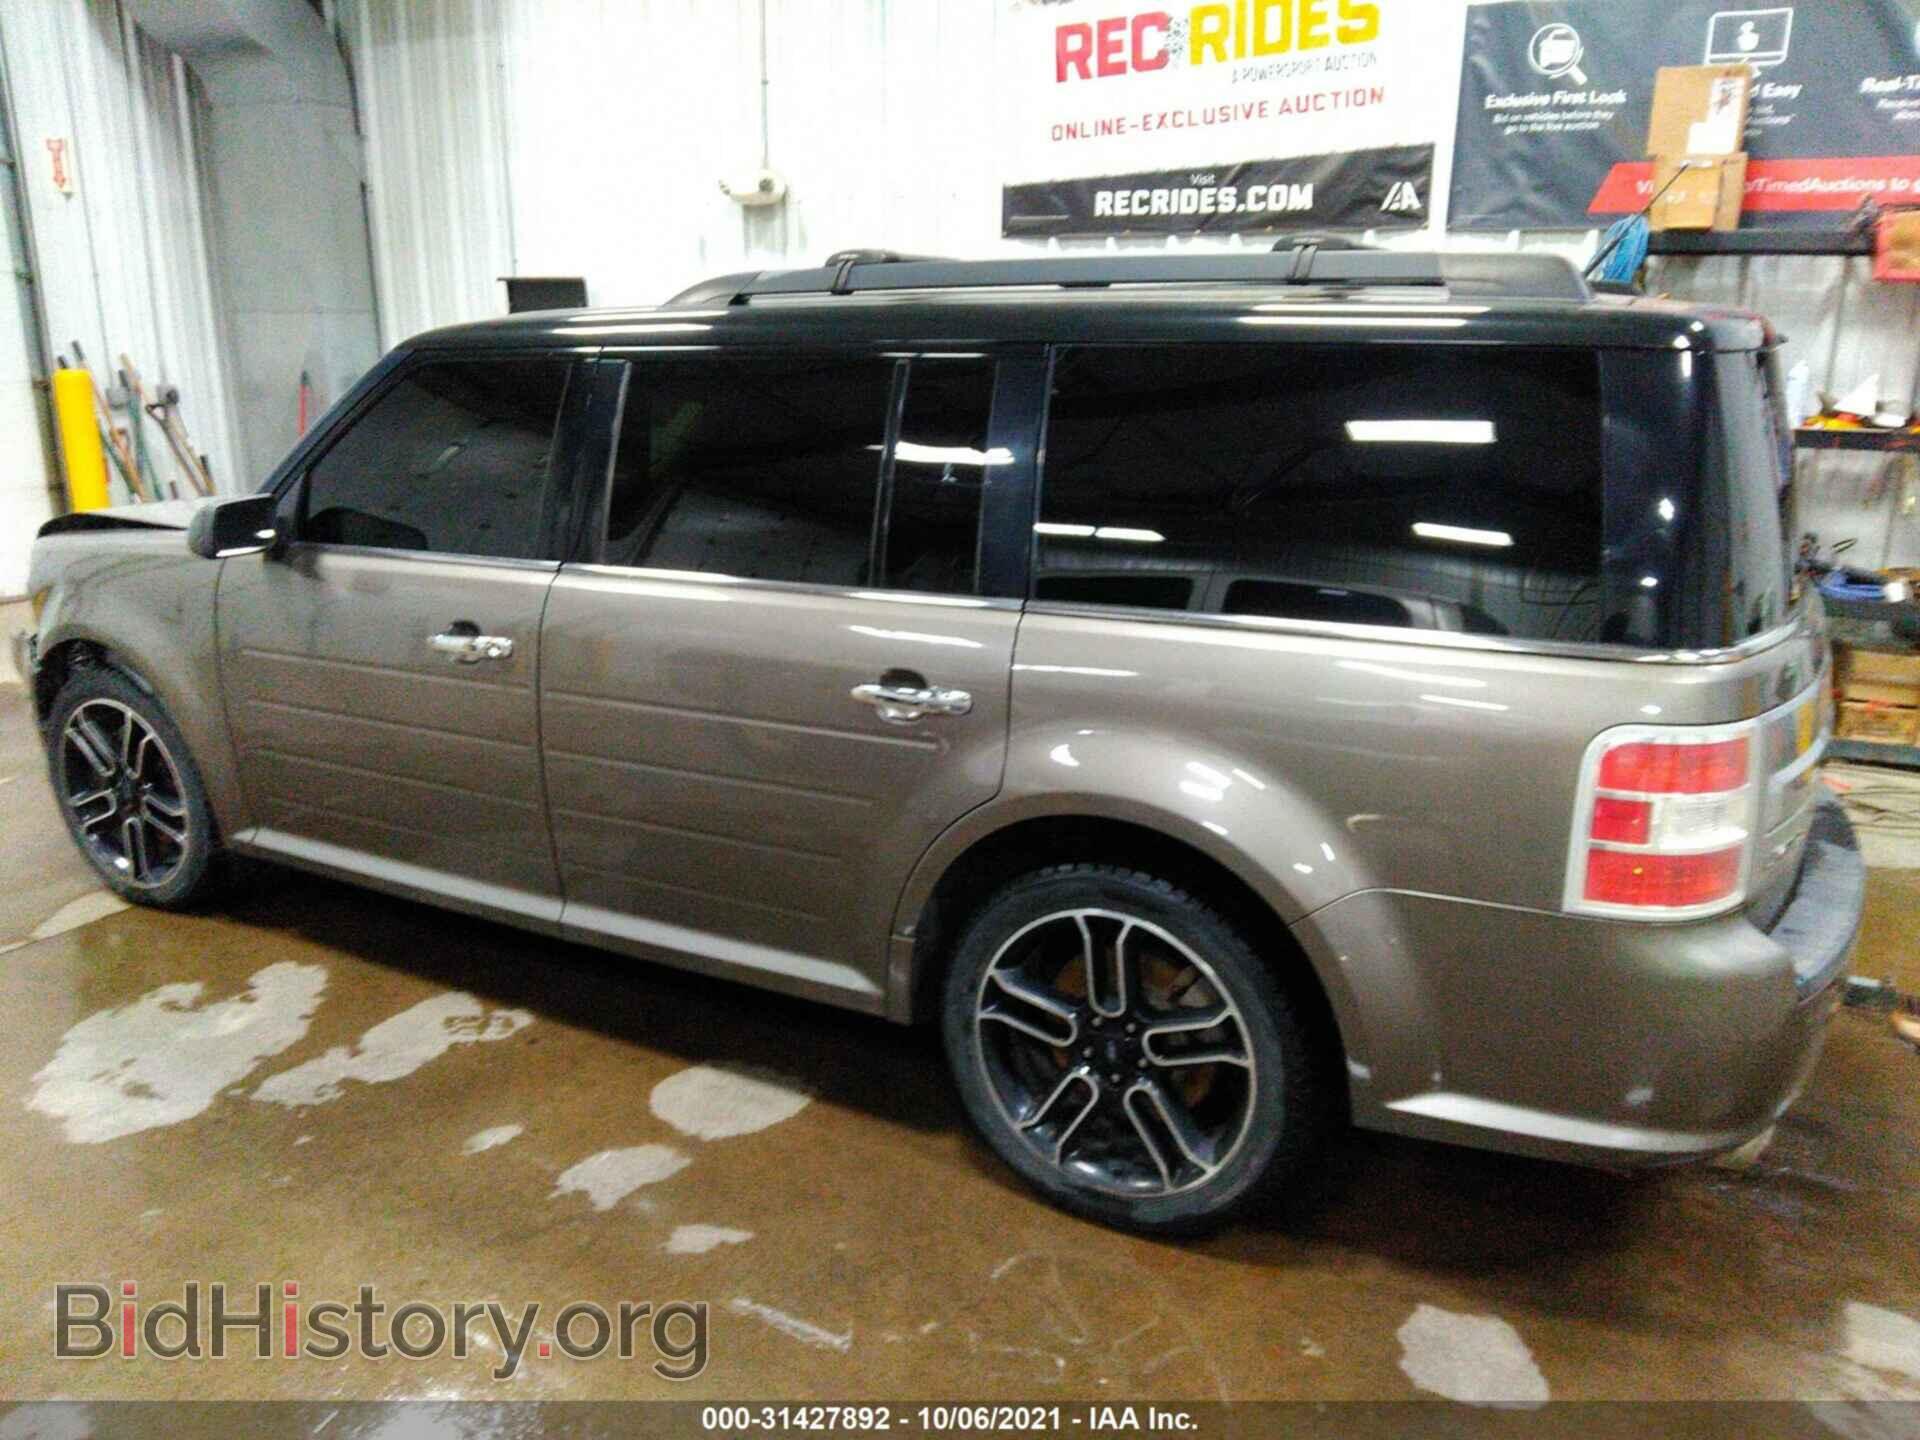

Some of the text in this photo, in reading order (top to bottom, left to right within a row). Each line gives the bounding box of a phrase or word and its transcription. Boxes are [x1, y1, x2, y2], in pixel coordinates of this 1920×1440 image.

[1056, 0, 1380, 83] REC RIDES
[1324, 51, 1377, 72] AUCTION
[1484, 88, 1628, 110] Exclusive First Look
[1761, 82, 1803, 100] Easy
[1051, 86, 1385, 142] ONLINE-EXCLUSIVE AUCTION
[1189, 172, 1216, 186] Visit
[1889, 177, 1910, 193] to
[1094, 183, 1314, 217] RECRIDES.COM
